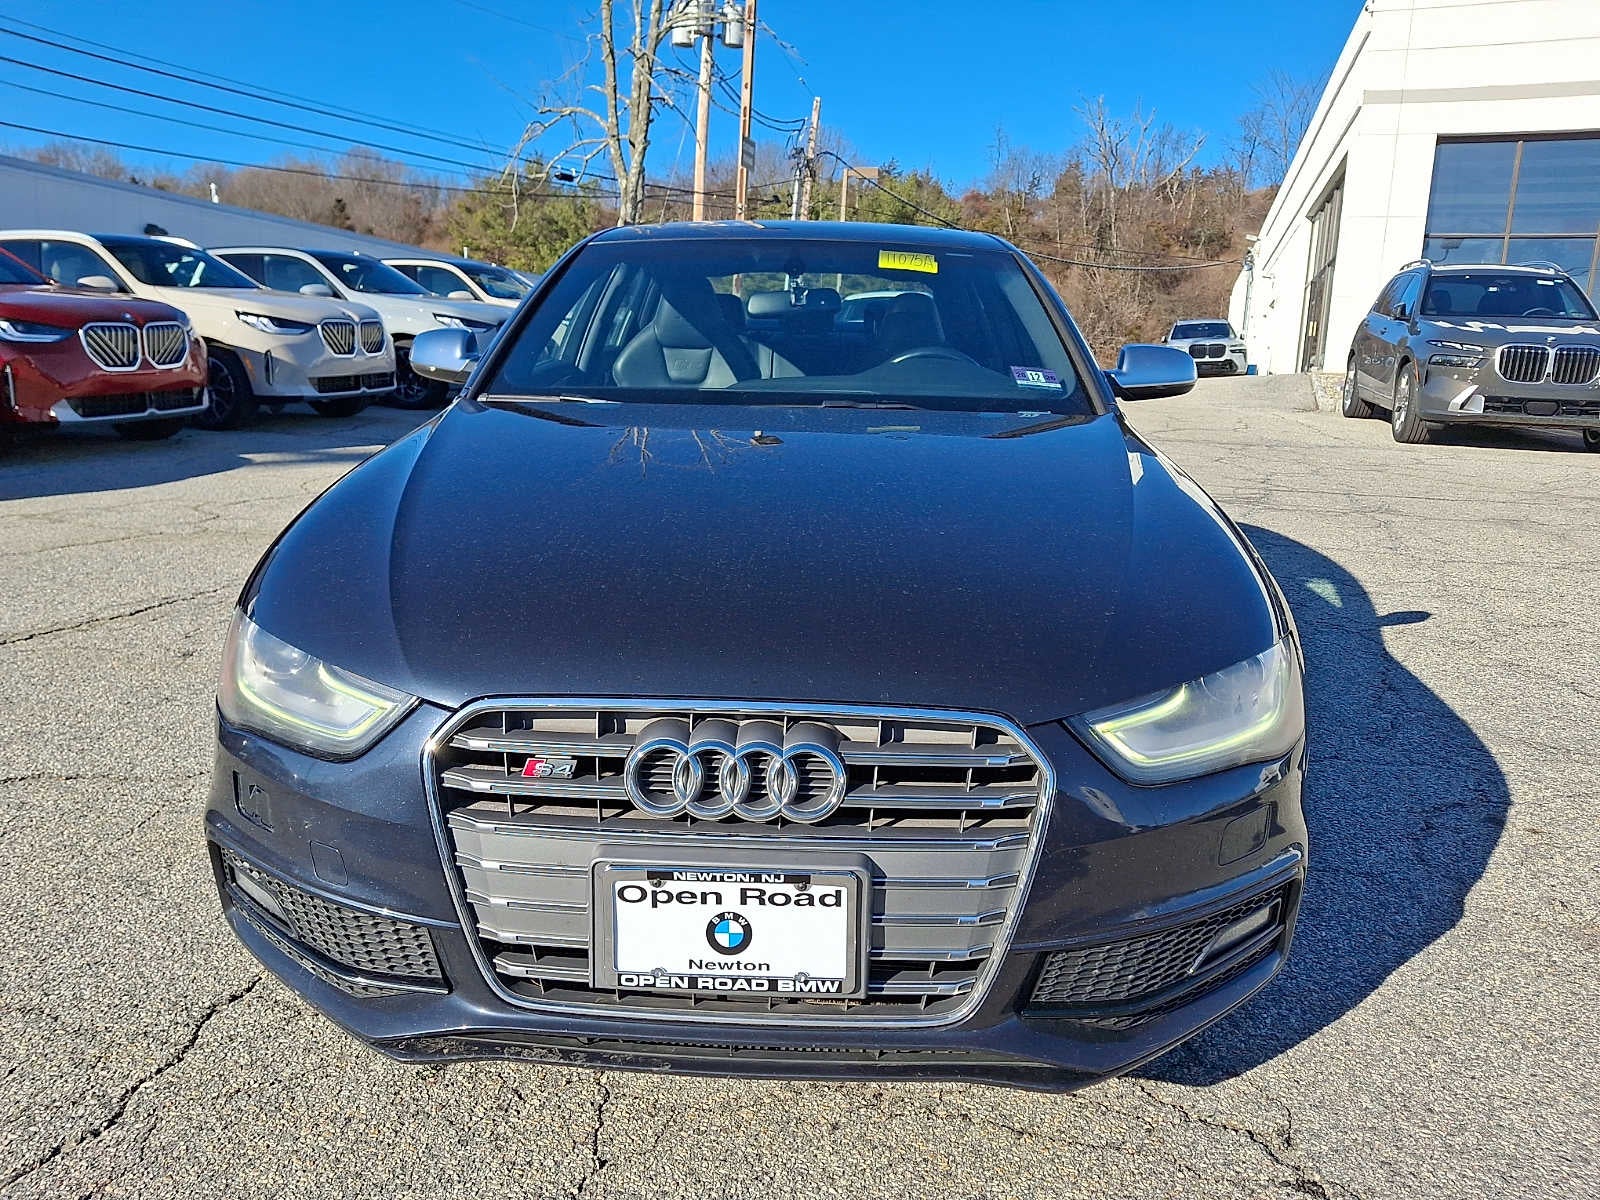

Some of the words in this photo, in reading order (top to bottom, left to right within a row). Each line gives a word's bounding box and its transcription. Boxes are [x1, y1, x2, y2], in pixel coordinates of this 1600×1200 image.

[1029, 372, 1041, 381] 12
[531, 762, 573, 778] S4
[673, 871, 755, 882] NEWTON,
[761, 874, 785, 883] NJ
[617, 885, 723, 908] Open
[740, 888, 842, 907] Road
[711, 912, 748, 926] BMW
[688, 959, 770, 971] Newton
[620, 974, 689, 989] OPEN
[697, 977, 769, 991] ROAD
[777, 979, 840, 993] BMW
